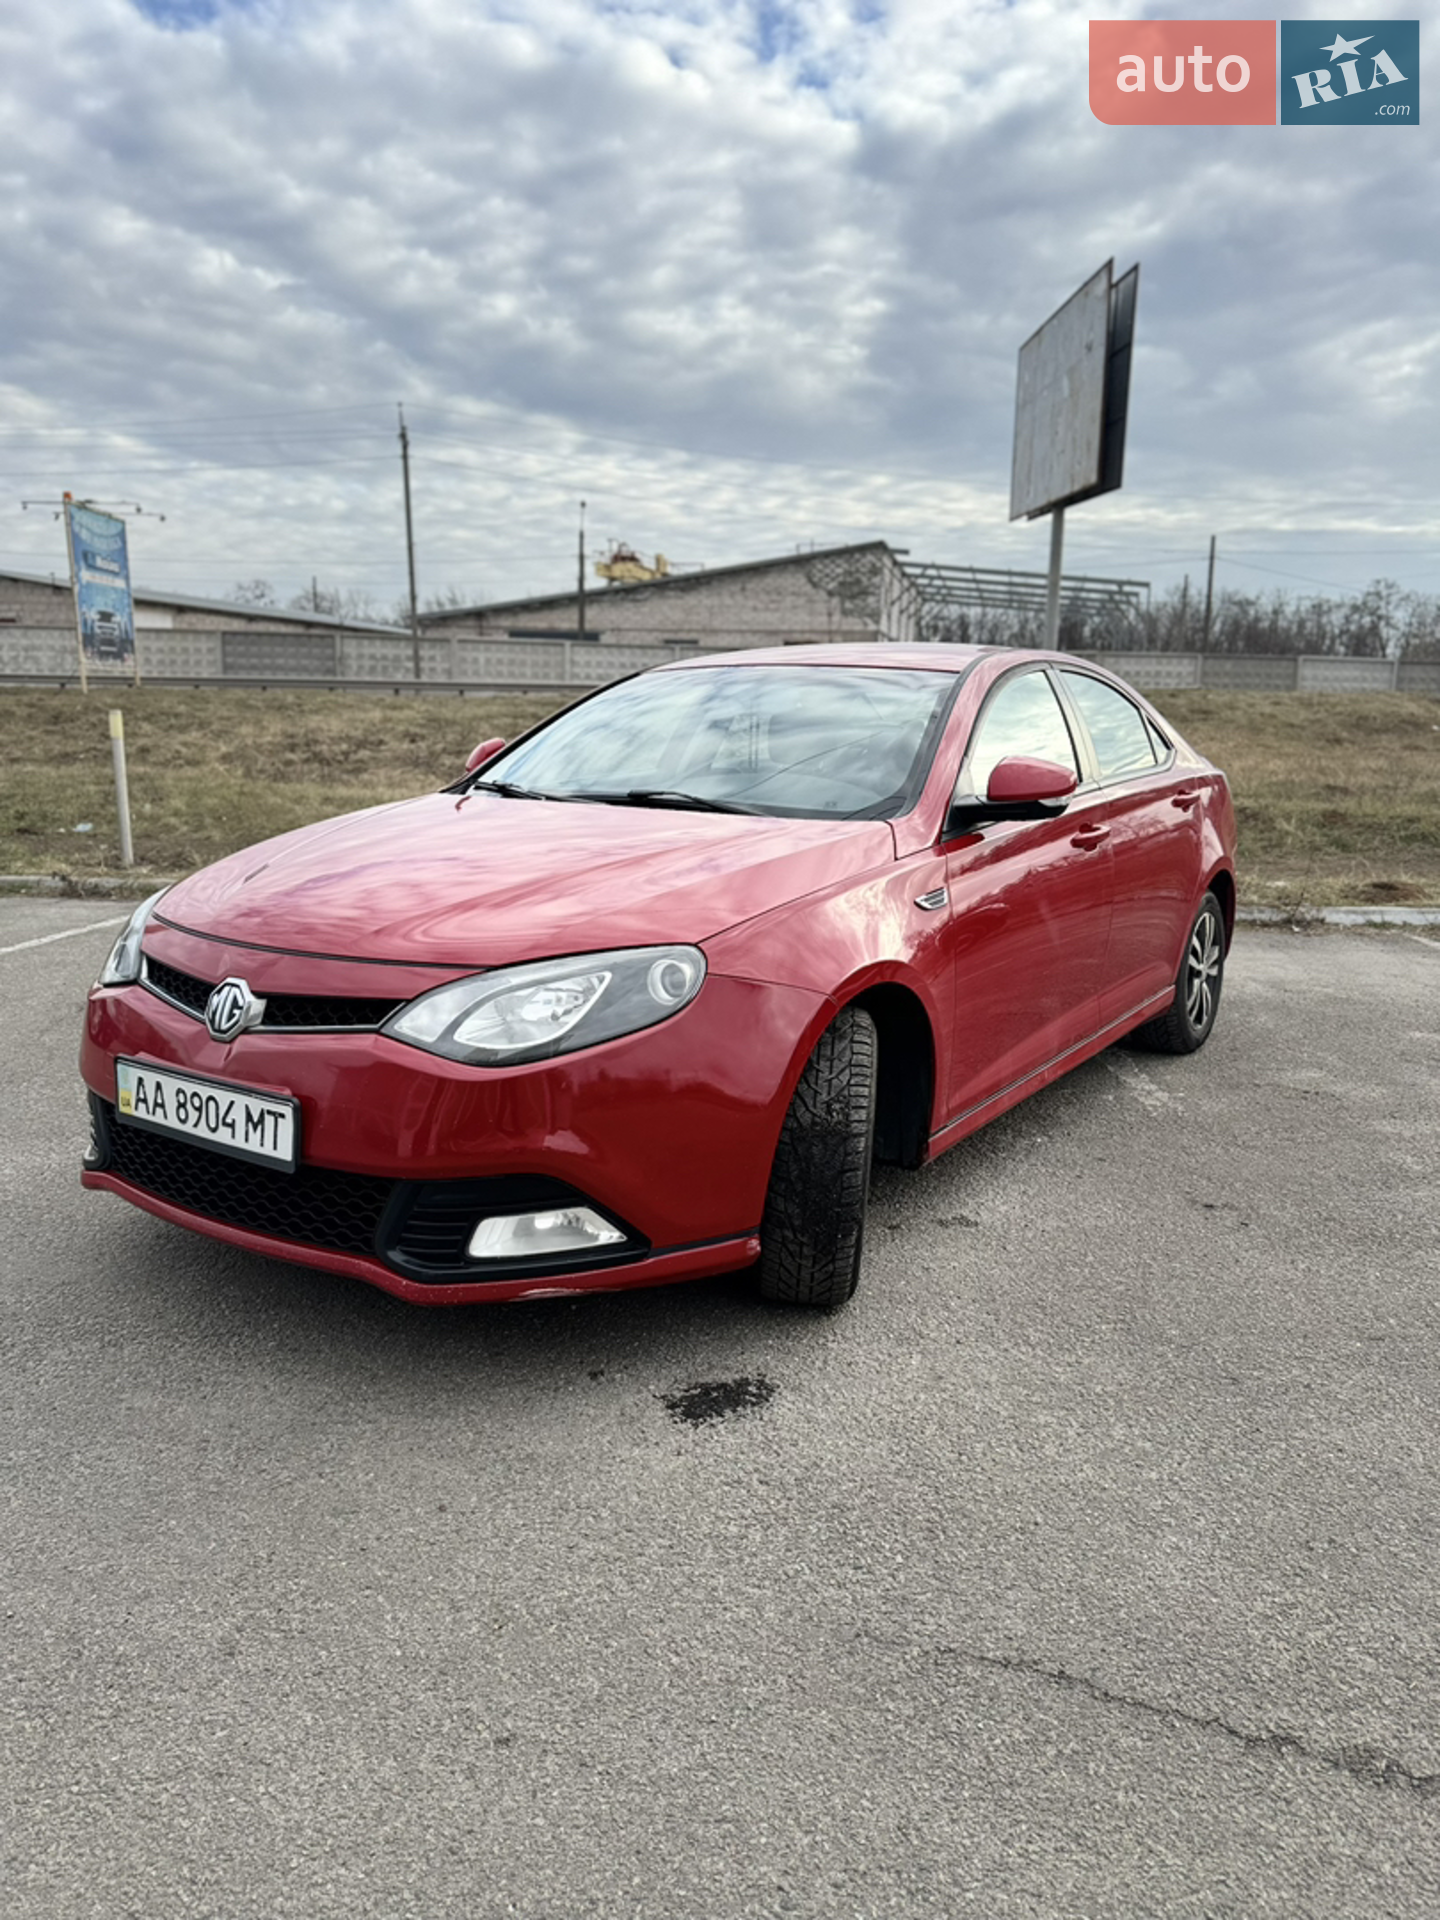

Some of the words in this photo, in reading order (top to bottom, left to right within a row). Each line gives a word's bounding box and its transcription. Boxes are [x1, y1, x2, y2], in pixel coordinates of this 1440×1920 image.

[208, 984, 245, 1031] MG
[134, 1076, 168, 1120] AA
[175, 1087, 236, 1139] 8904
[244, 1103, 286, 1151] MT
